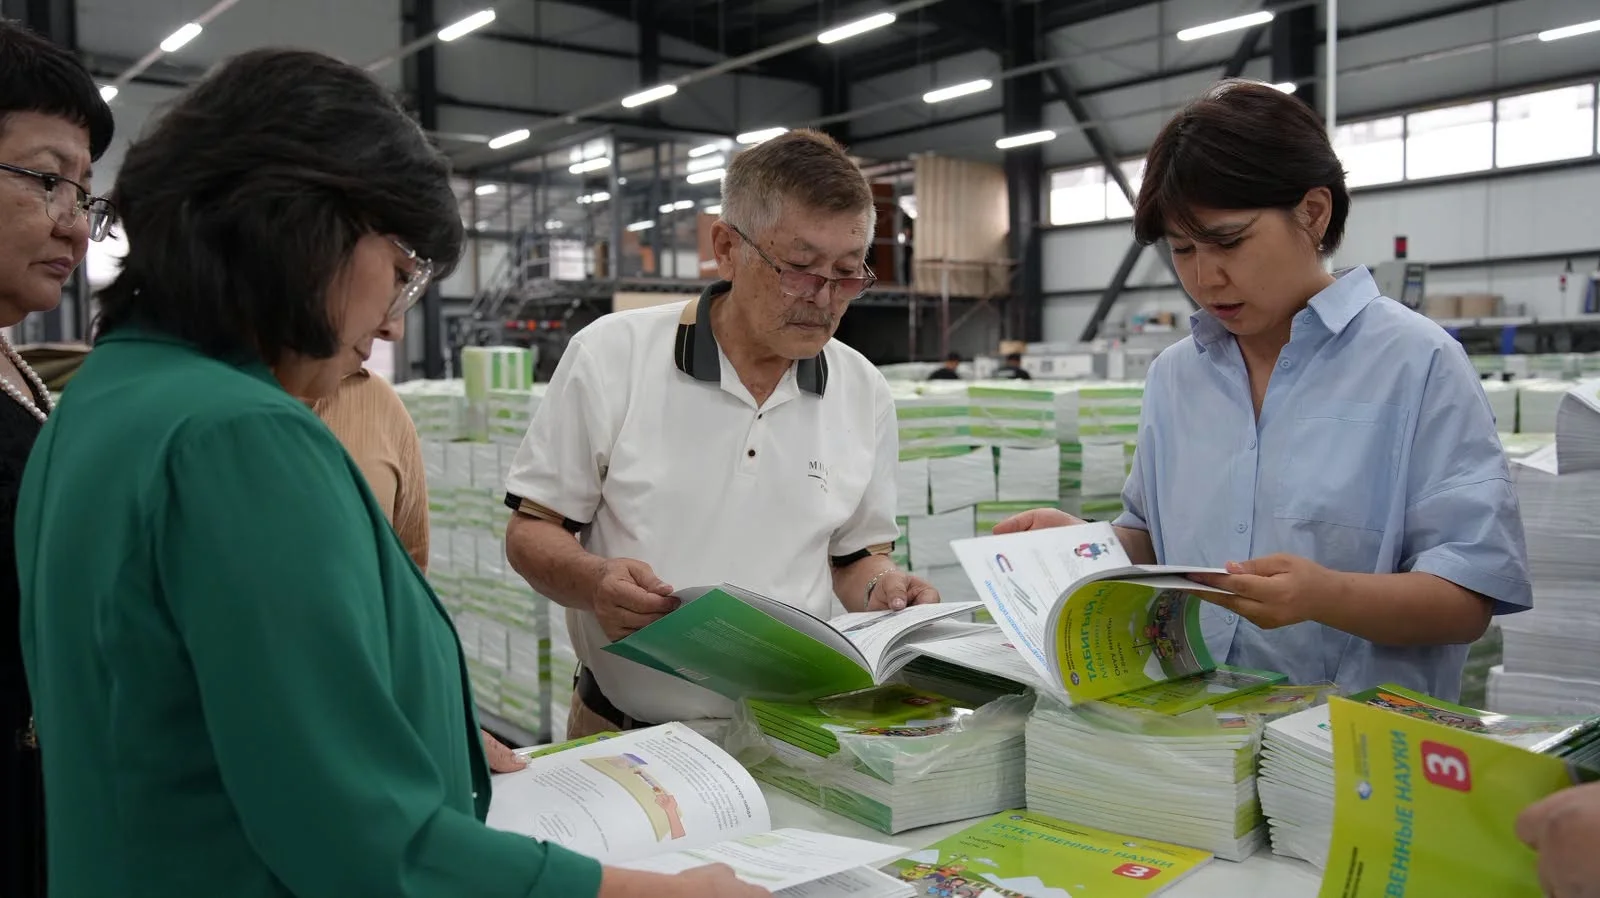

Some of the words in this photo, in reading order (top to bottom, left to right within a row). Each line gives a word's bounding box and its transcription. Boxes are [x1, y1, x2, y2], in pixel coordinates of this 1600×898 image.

[1080, 599, 1098, 683] ТАБИГЫЙ
[1390, 728, 1414, 803] НАУКИ
[1425, 752, 1466, 783] 3
[992, 822, 1112, 855] ЕСТЕСТВЕННЫЕ
[1113, 850, 1176, 868] НАУКИ
[1122, 864, 1150, 878] 3
